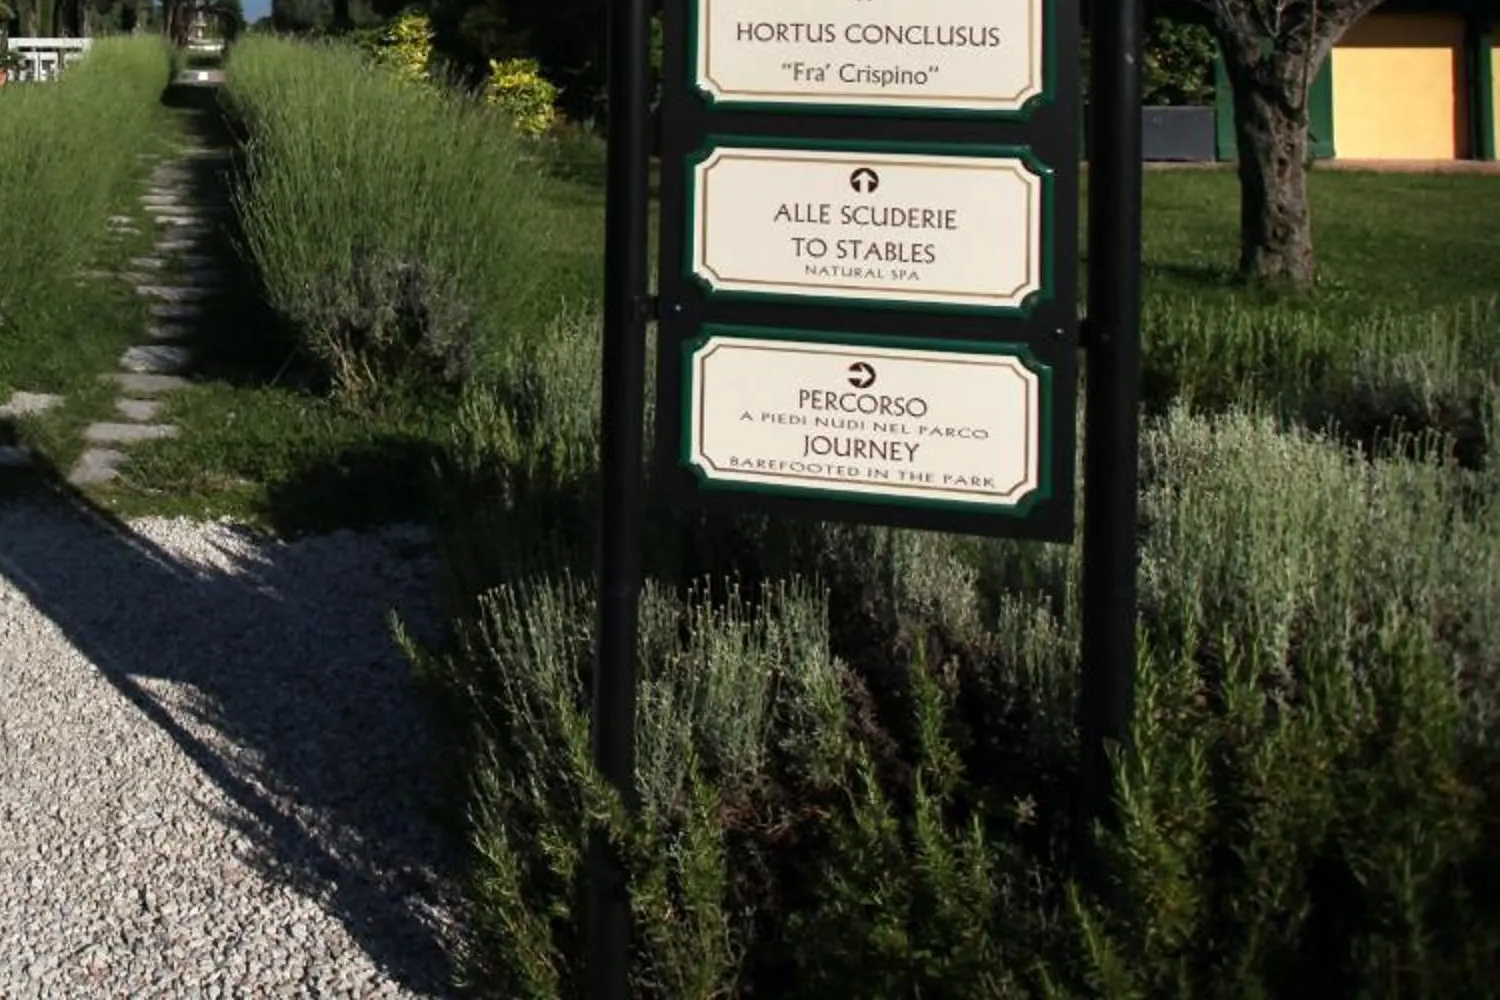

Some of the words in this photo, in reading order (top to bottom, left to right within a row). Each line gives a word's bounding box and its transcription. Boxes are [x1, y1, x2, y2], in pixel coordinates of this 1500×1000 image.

[737, 22, 835, 44] HORTUS
[845, 24, 1000, 47] CONCLUSUS
[839, 63, 939, 88] Crispino"
[774, 204, 831, 225] ALLE
[840, 205, 957, 230] SCUDERIE
[792, 237, 827, 258] TO
[837, 239, 936, 264] STABLES
[805, 265, 884, 279] NATURAL
[891, 269, 920, 281] SPA
[799, 389, 928, 418] PERCORSO
[740, 410, 753, 422] A
[761, 411, 807, 425] PIEDI
[815, 416, 865, 430] NUDI
[873, 421, 910, 435] NEL
[919, 424, 989, 440] PARCO
[803, 435, 920, 462] JOURNEY
[729, 455, 860, 477] BAREFOOTED
[868, 467, 889, 479] IN
[898, 470, 935, 483] THE
[944, 474, 996, 488] PARK
